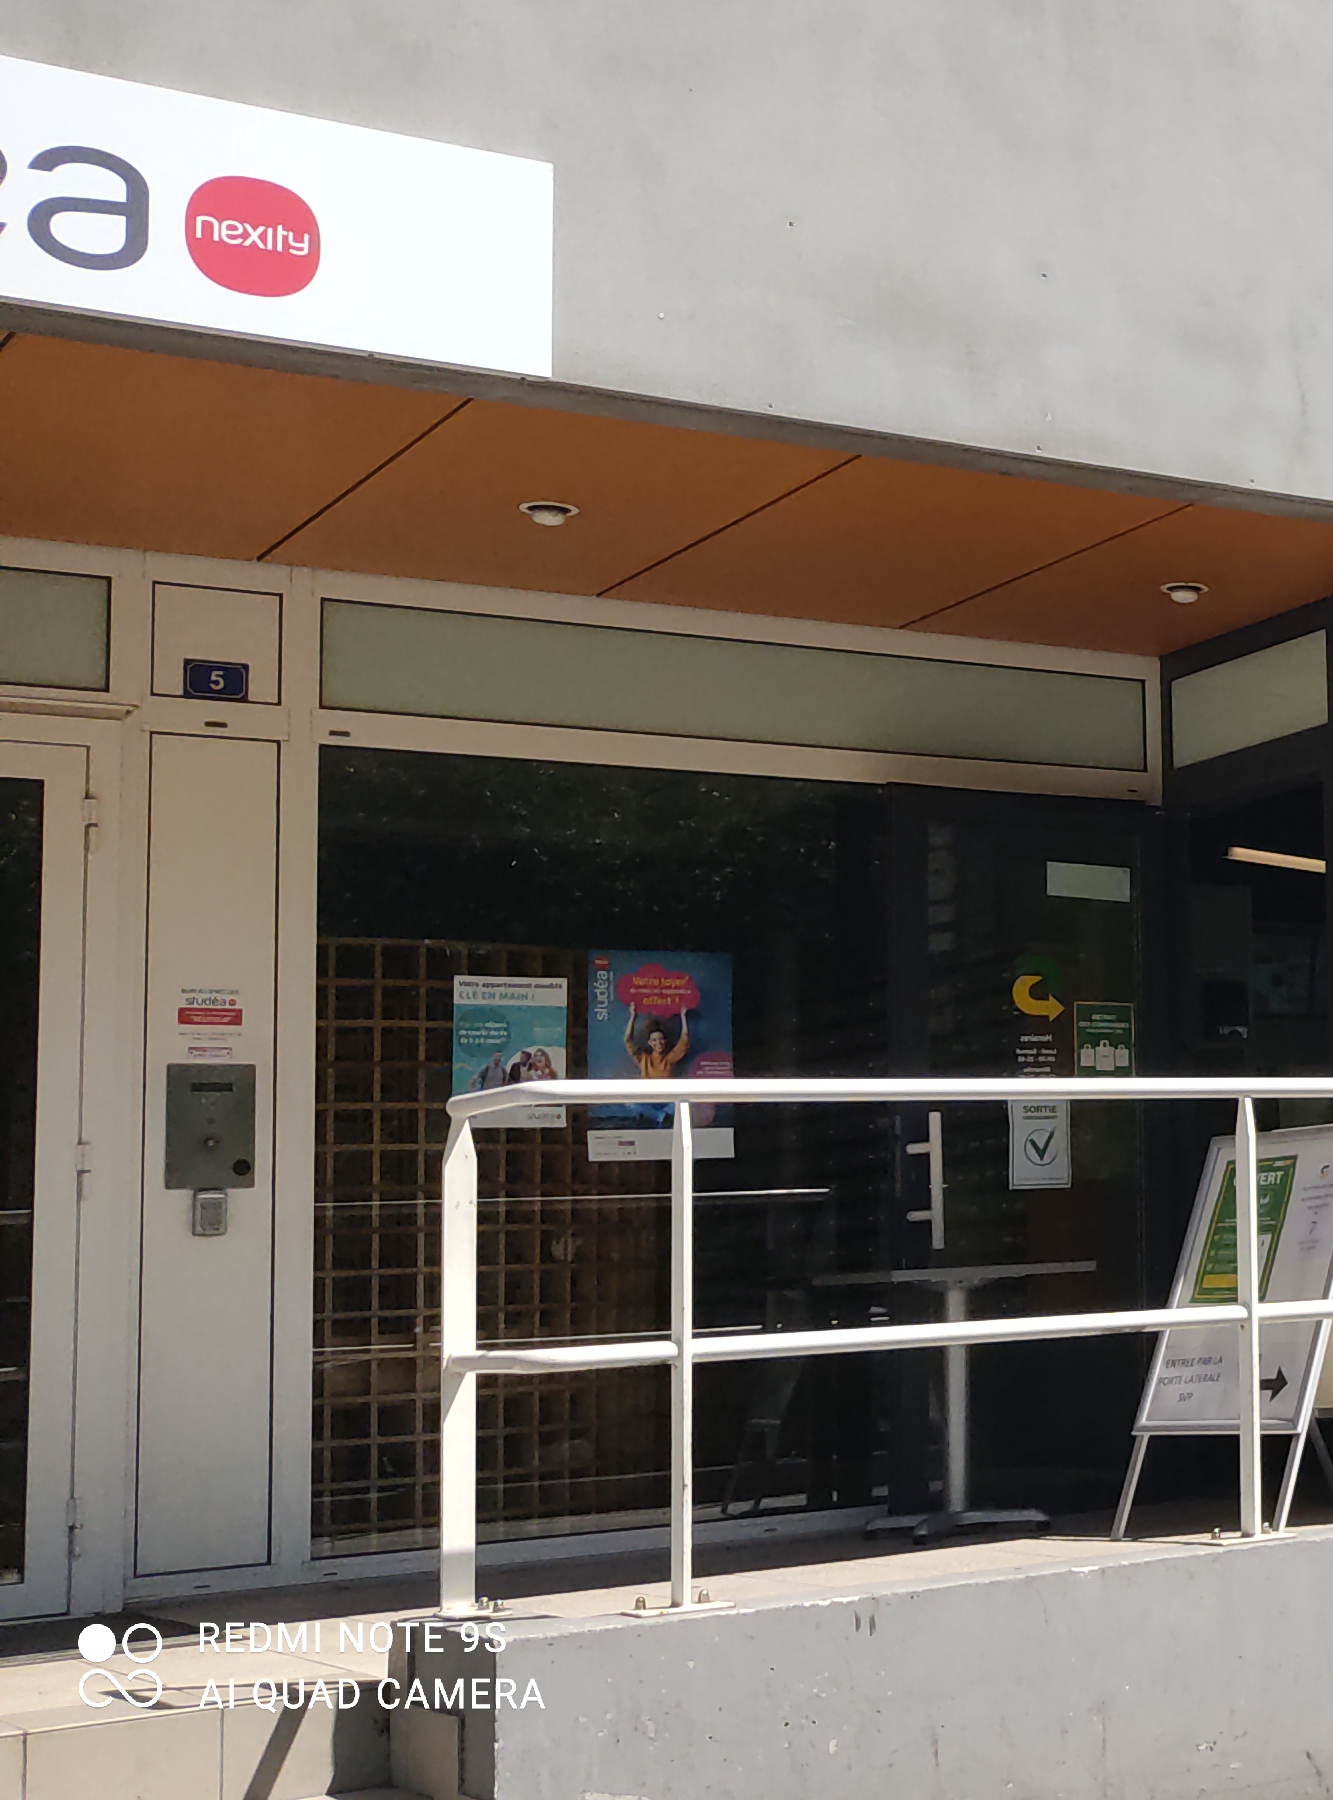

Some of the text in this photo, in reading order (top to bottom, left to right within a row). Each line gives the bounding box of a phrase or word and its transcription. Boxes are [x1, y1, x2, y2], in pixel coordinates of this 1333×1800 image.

[0, 145, 149, 271] a
[195, 215, 310, 256] nexity
[209, 671, 225, 690] 5
[185, 996, 227, 1007] studéa
[482, 992, 496, 1000] EN
[499, 992, 529, 1000] MAIN
[1022, 1105, 1057, 1114] SORTIE
